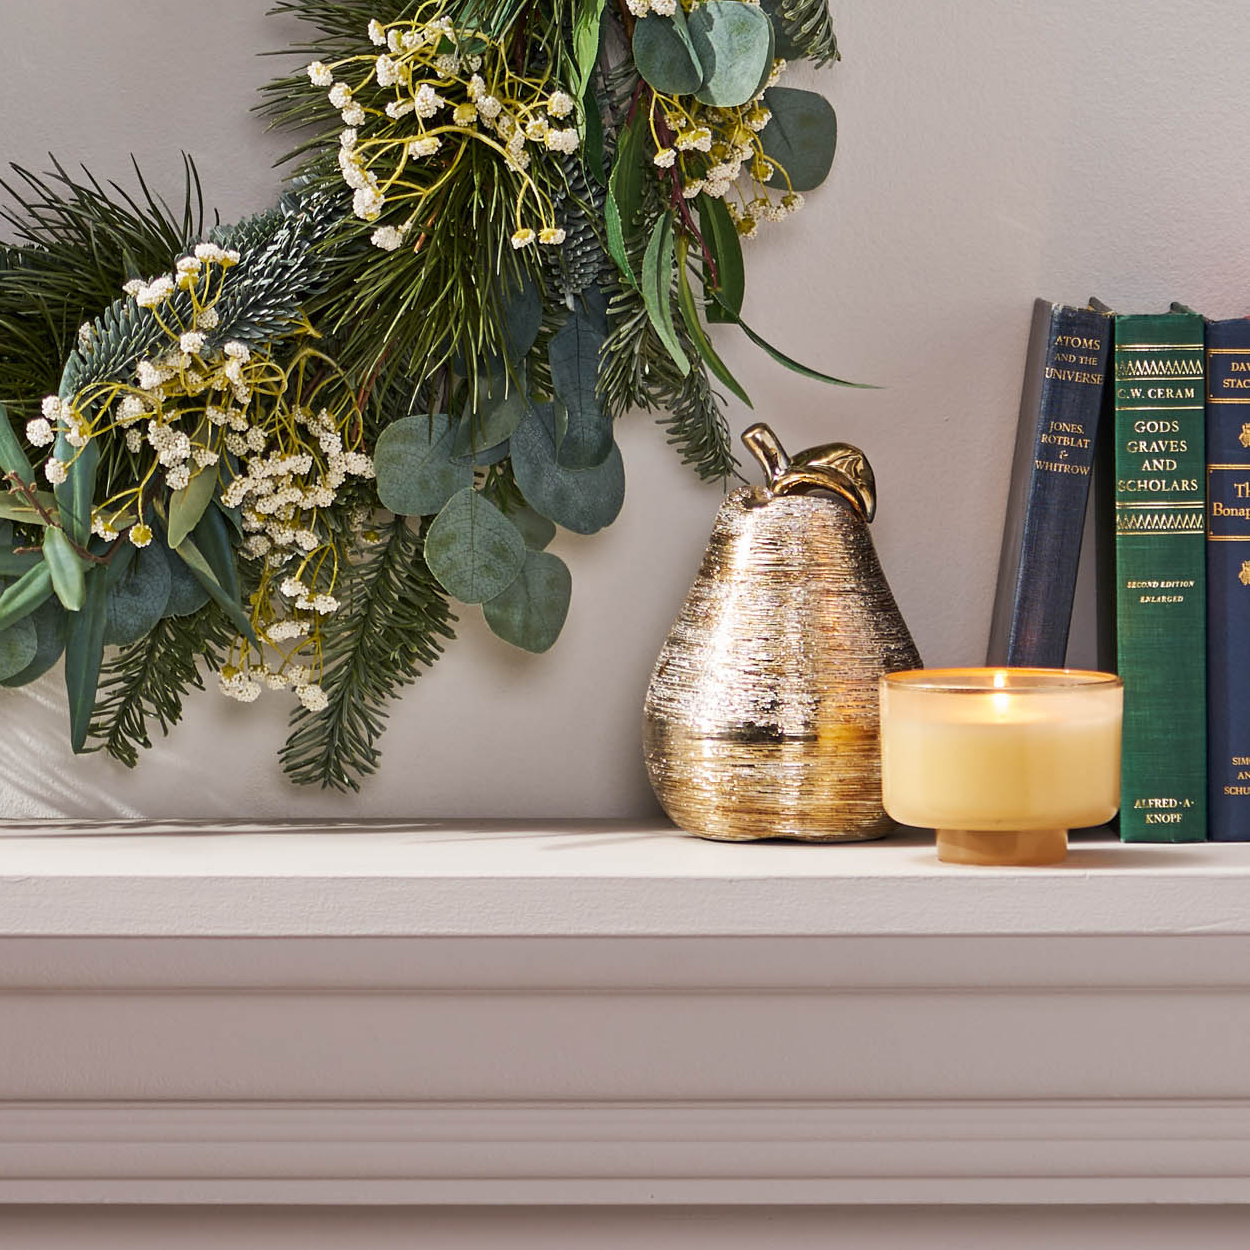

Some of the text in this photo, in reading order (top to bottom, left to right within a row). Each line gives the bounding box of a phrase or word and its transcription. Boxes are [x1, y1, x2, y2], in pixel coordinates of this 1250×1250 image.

[1054, 335, 1100, 350] ATOMS
[1054, 353, 1098, 366] AND THE
[1045, 367, 1102, 384] UNIVERSE
[1147, 388, 1195, 398] CERAM
[1134, 421, 1180, 433] GODS
[1041, 434, 1090, 448] ROTBLAT
[1127, 441, 1188, 453] GRAVES
[1059, 450, 1068, 459] &
[1035, 460, 1090, 475] WHITROW
[1142, 459, 1177, 471] AND
[1118, 479, 1199, 492] SCHOLARS
[1160, 580, 1195, 588] EDITION
[1140, 595, 1184, 603] ENLARGED
[1232, 757, 1250, 766] SIM
[1146, 813, 1182, 824] KNOPF
